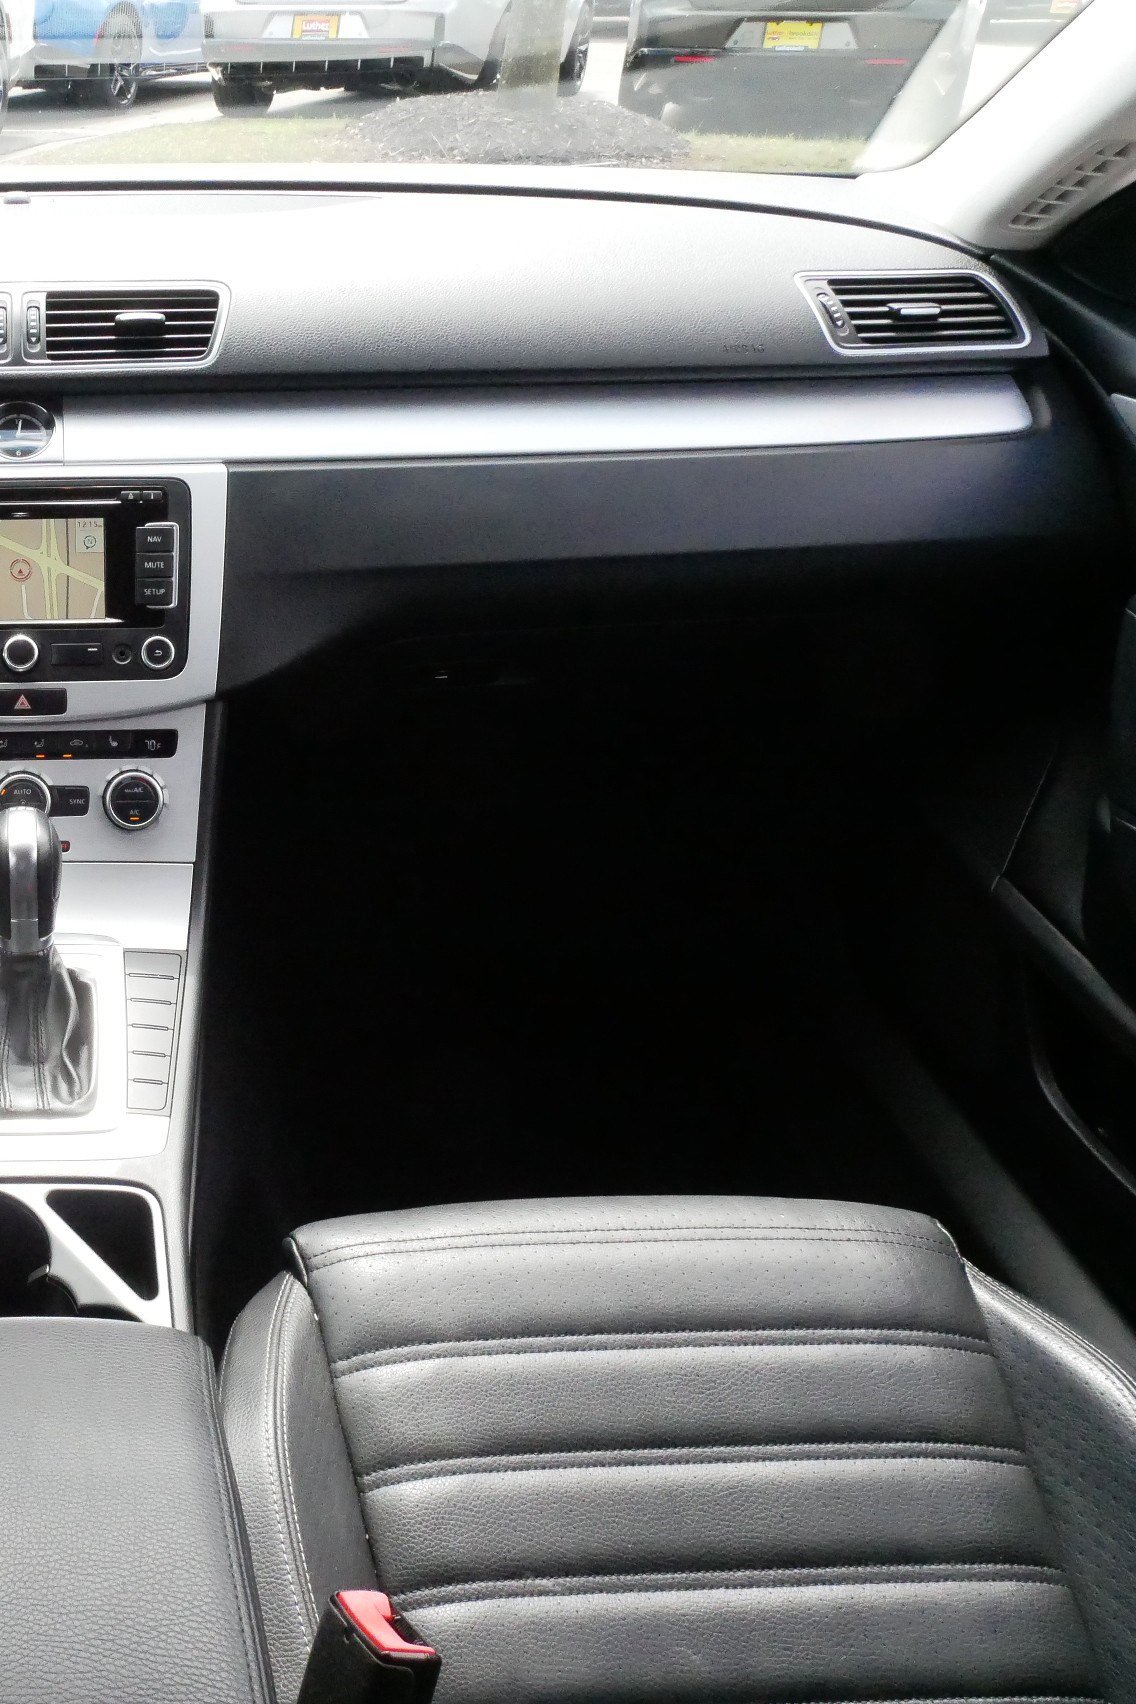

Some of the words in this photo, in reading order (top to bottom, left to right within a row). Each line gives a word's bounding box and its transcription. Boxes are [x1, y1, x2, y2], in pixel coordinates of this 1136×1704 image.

[147, 535, 163, 543] NAV
[144, 561, 165, 569] MUTE
[144, 588, 166, 596] SETUP
[13, 788, 32, 796] AUTO
[69, 798, 86, 806] SYNC
[129, 808, 141, 816] A/C
